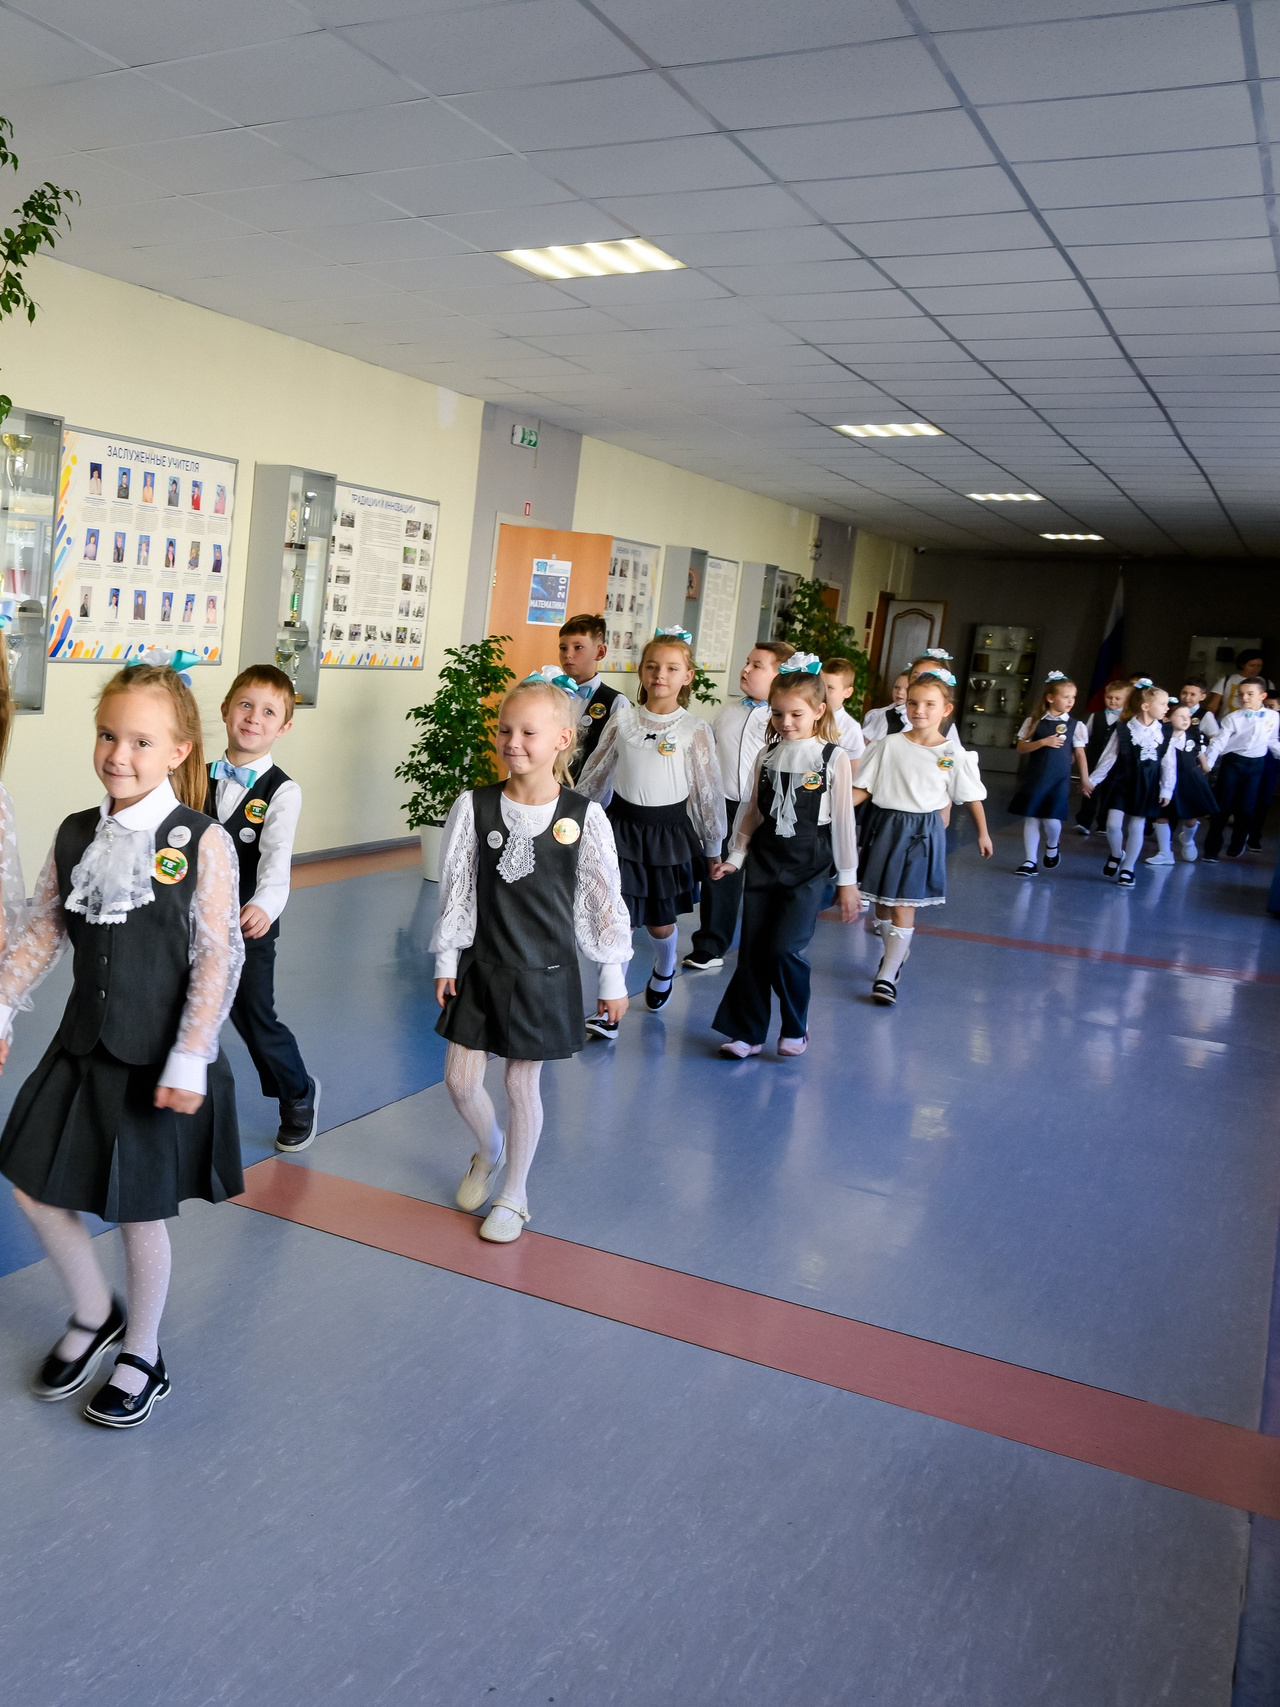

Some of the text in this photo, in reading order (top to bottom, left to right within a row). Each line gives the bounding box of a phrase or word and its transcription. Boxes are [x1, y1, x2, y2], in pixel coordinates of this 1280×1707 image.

[106, 445, 200, 473] ЗАСЛУЖЕННЫЕ УЧИТЕЛЯ
[557, 577, 568, 599] 210
[529, 599, 565, 610] МАТЕМАТИКА
